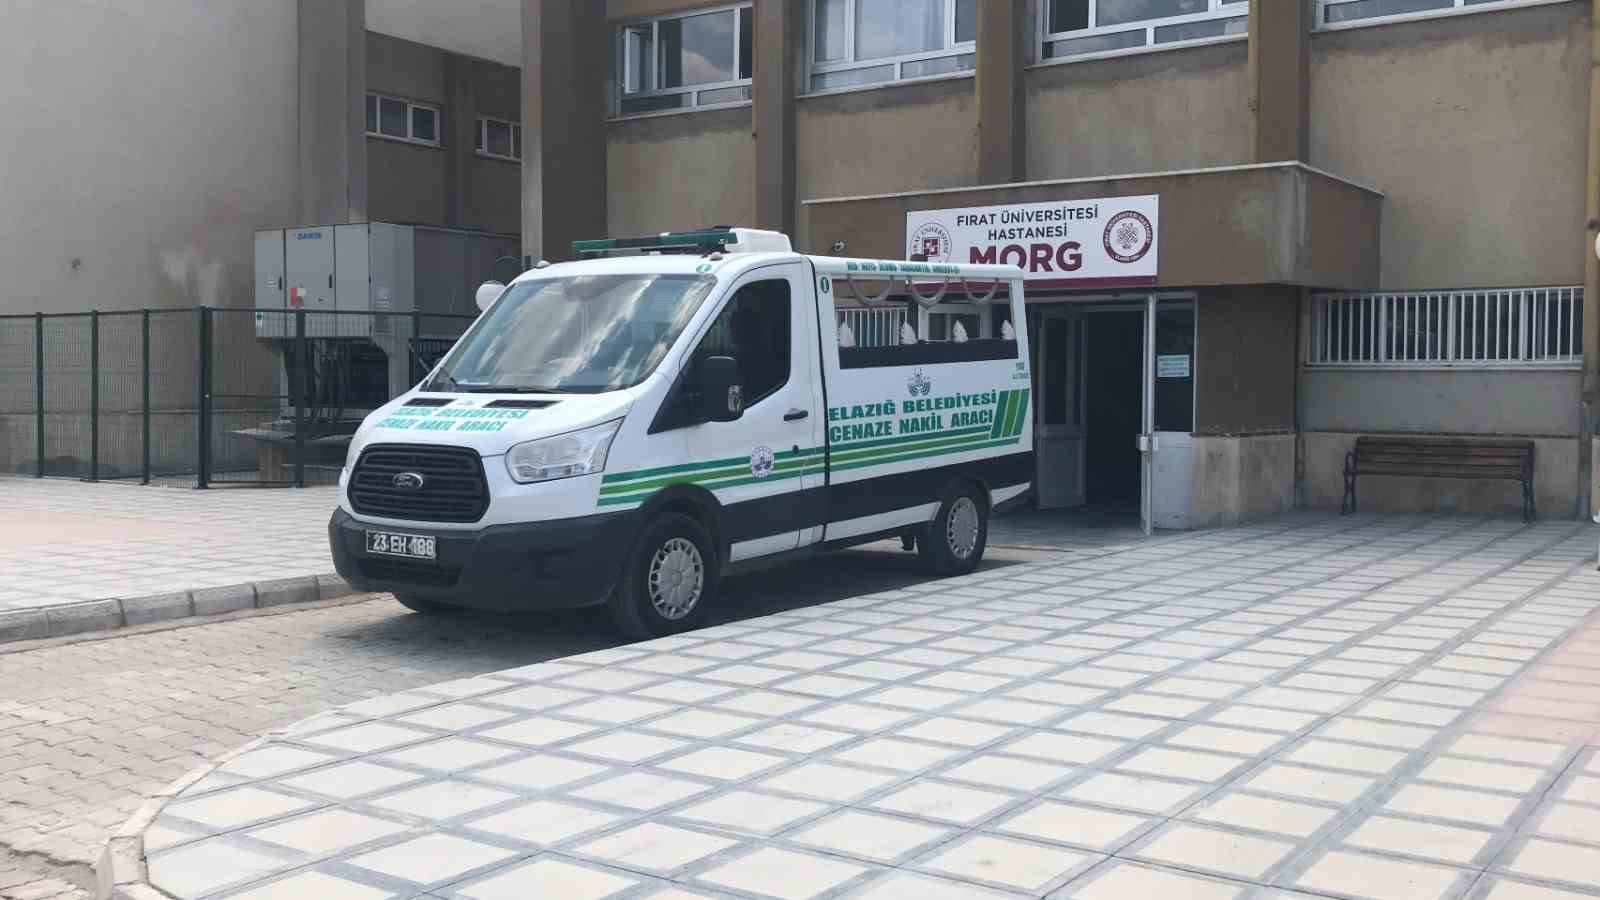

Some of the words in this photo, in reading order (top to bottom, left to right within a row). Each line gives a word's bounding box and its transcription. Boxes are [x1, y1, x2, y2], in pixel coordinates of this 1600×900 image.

[956, 213, 997, 227] FIRAT
[1000, 204, 1098, 225] ÜNİVERSİTESİ
[988, 225, 1067, 241] HASTANESİ
[969, 240, 1082, 273] MORG
[829, 398, 896, 421] ELAZIĞ
[902, 388, 997, 414] BELEDİYESİ
[829, 420, 892, 442] CENAZE
[899, 412, 944, 433] NAKİL
[951, 409, 993, 428] ARACI
[373, 534, 387, 551] 23
[390, 535, 407, 553] EH
